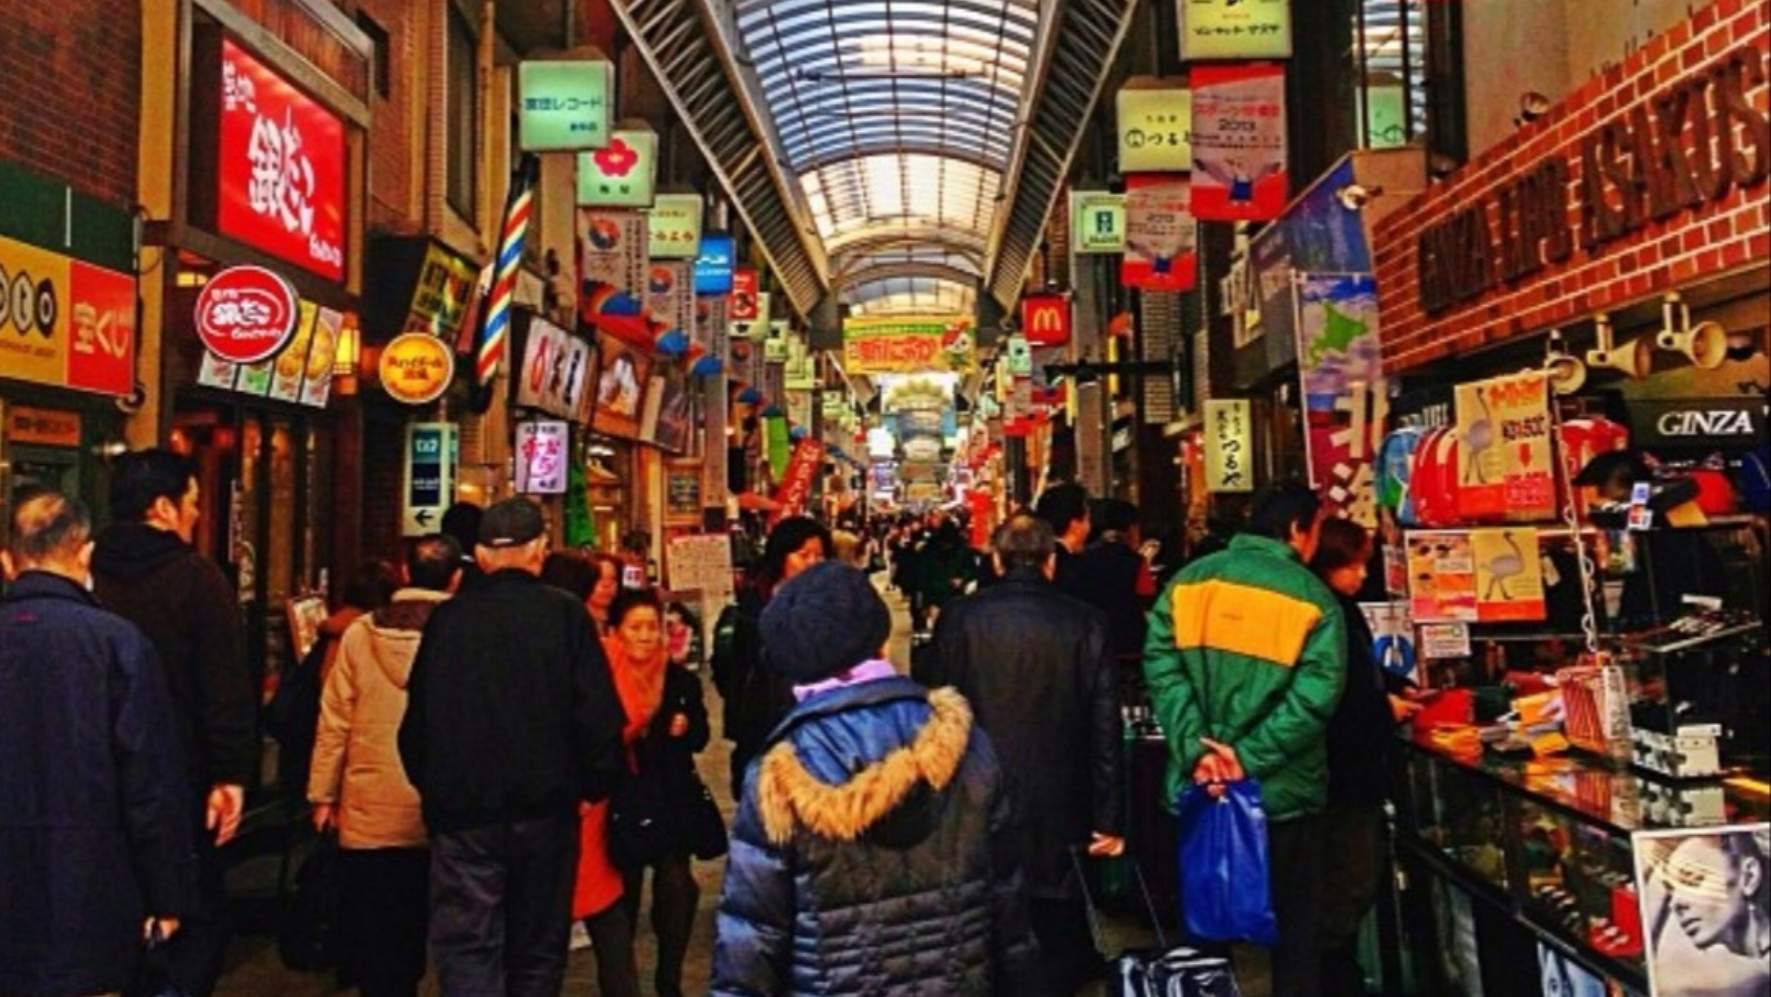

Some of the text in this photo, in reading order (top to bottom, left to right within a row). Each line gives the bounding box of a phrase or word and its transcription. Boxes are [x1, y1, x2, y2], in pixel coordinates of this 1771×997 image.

[1218, 118, 1256, 131] 2013
[1658, 410, 1754, 435] GINZA
[1221, 439, 1242, 487] つるや
